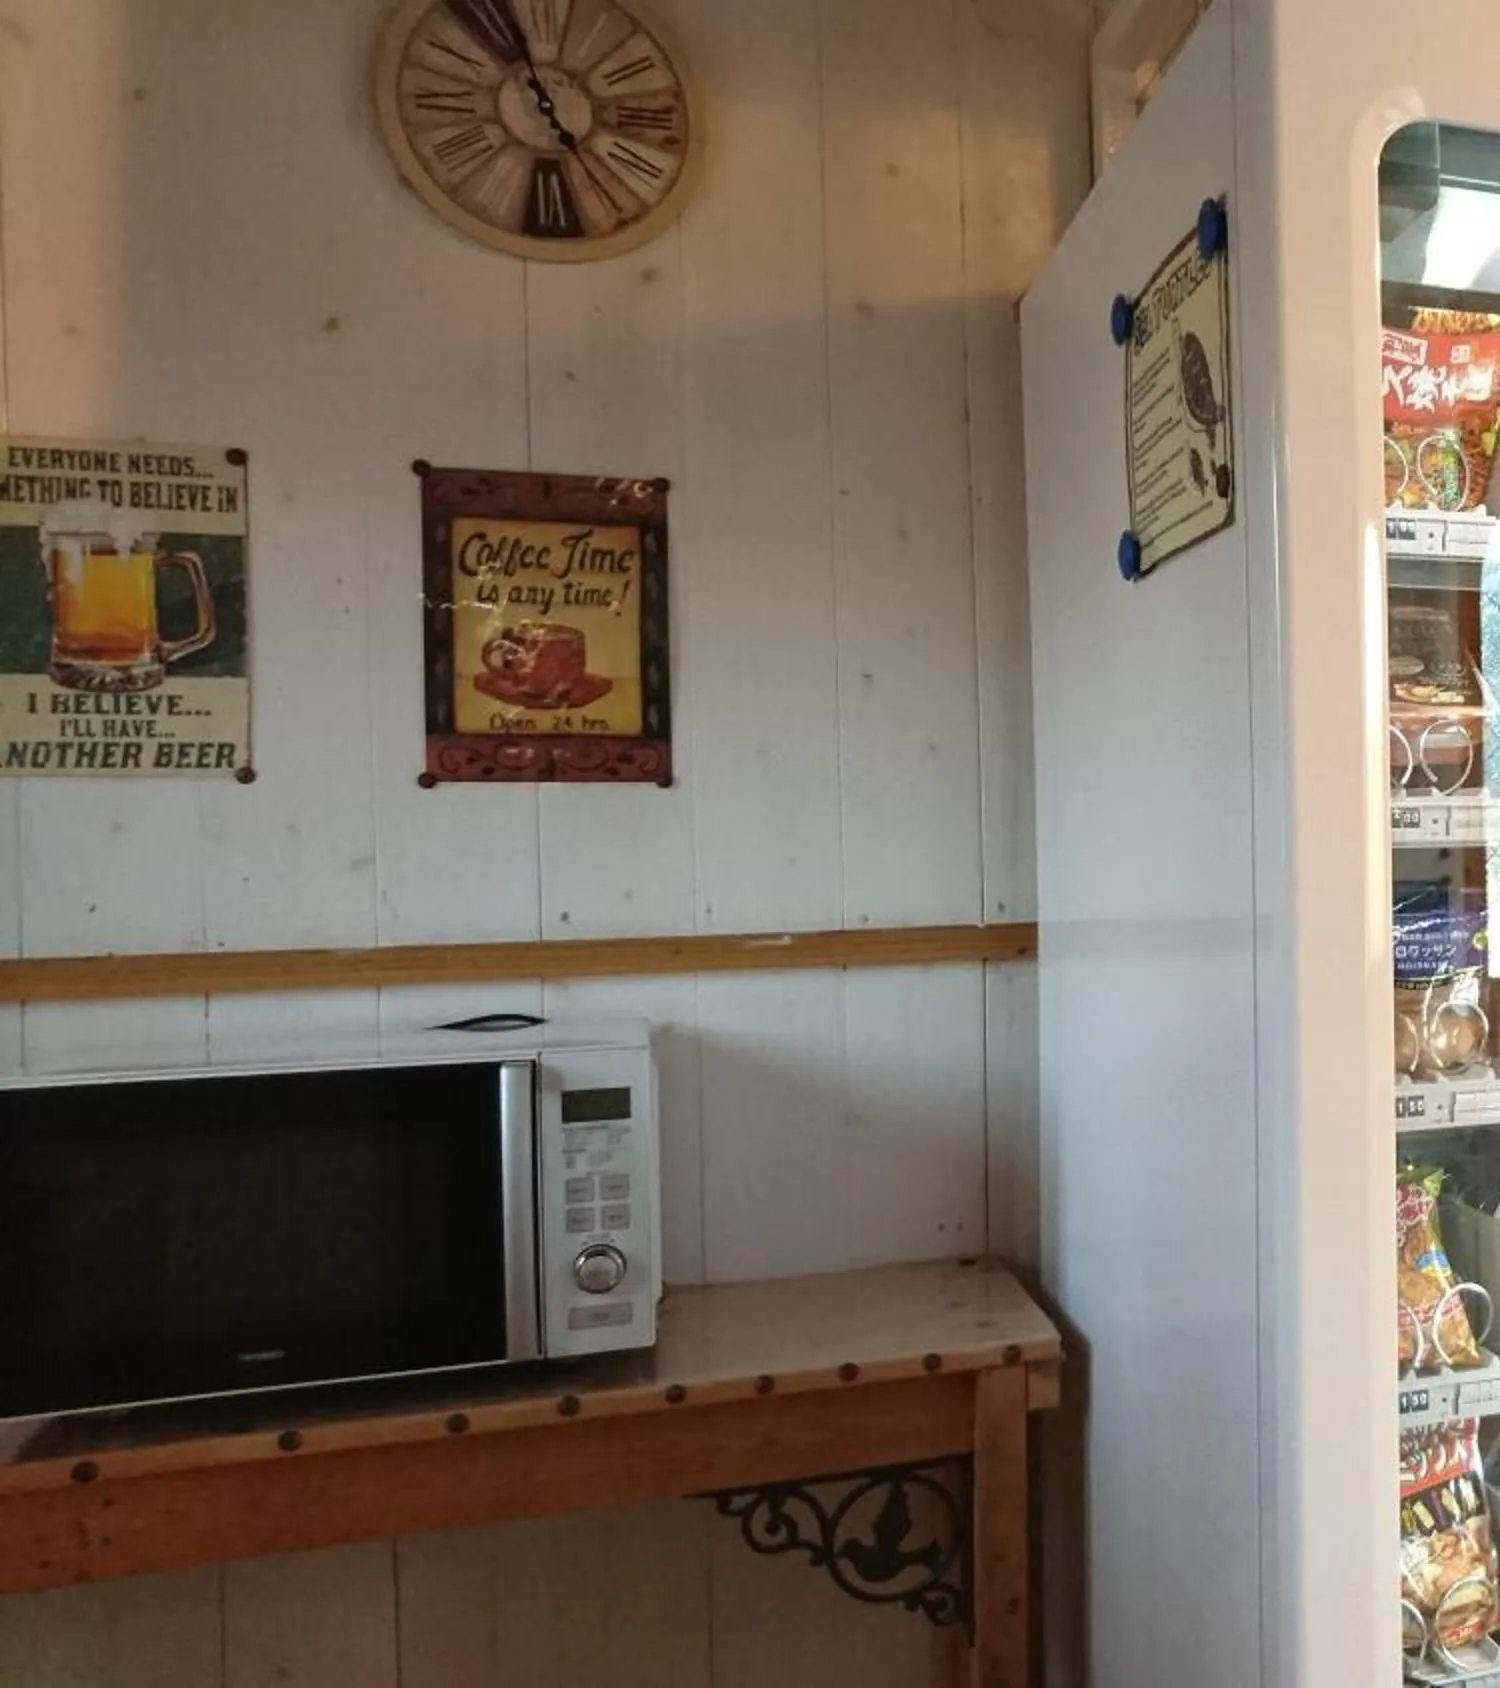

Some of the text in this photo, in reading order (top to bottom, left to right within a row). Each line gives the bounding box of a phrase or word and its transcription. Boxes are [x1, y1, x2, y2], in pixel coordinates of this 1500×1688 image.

[7, 446, 215, 478] EVERYONE NEEDS...
[97, 478, 123, 508] TO
[130, 480, 213, 512] BELIEVE
[218, 486, 239, 513] IN
[459, 527, 635, 580] Coffee Time
[476, 582, 499, 603] is
[507, 583, 555, 616] any
[26, 691, 213, 718] I BELIEVE...
[59, 718, 177, 740] I'LL HAVE...
[489, 712, 537, 734] Open
[552, 714, 572, 732] 24
[0, 741, 238, 769] NOTHER BEER
